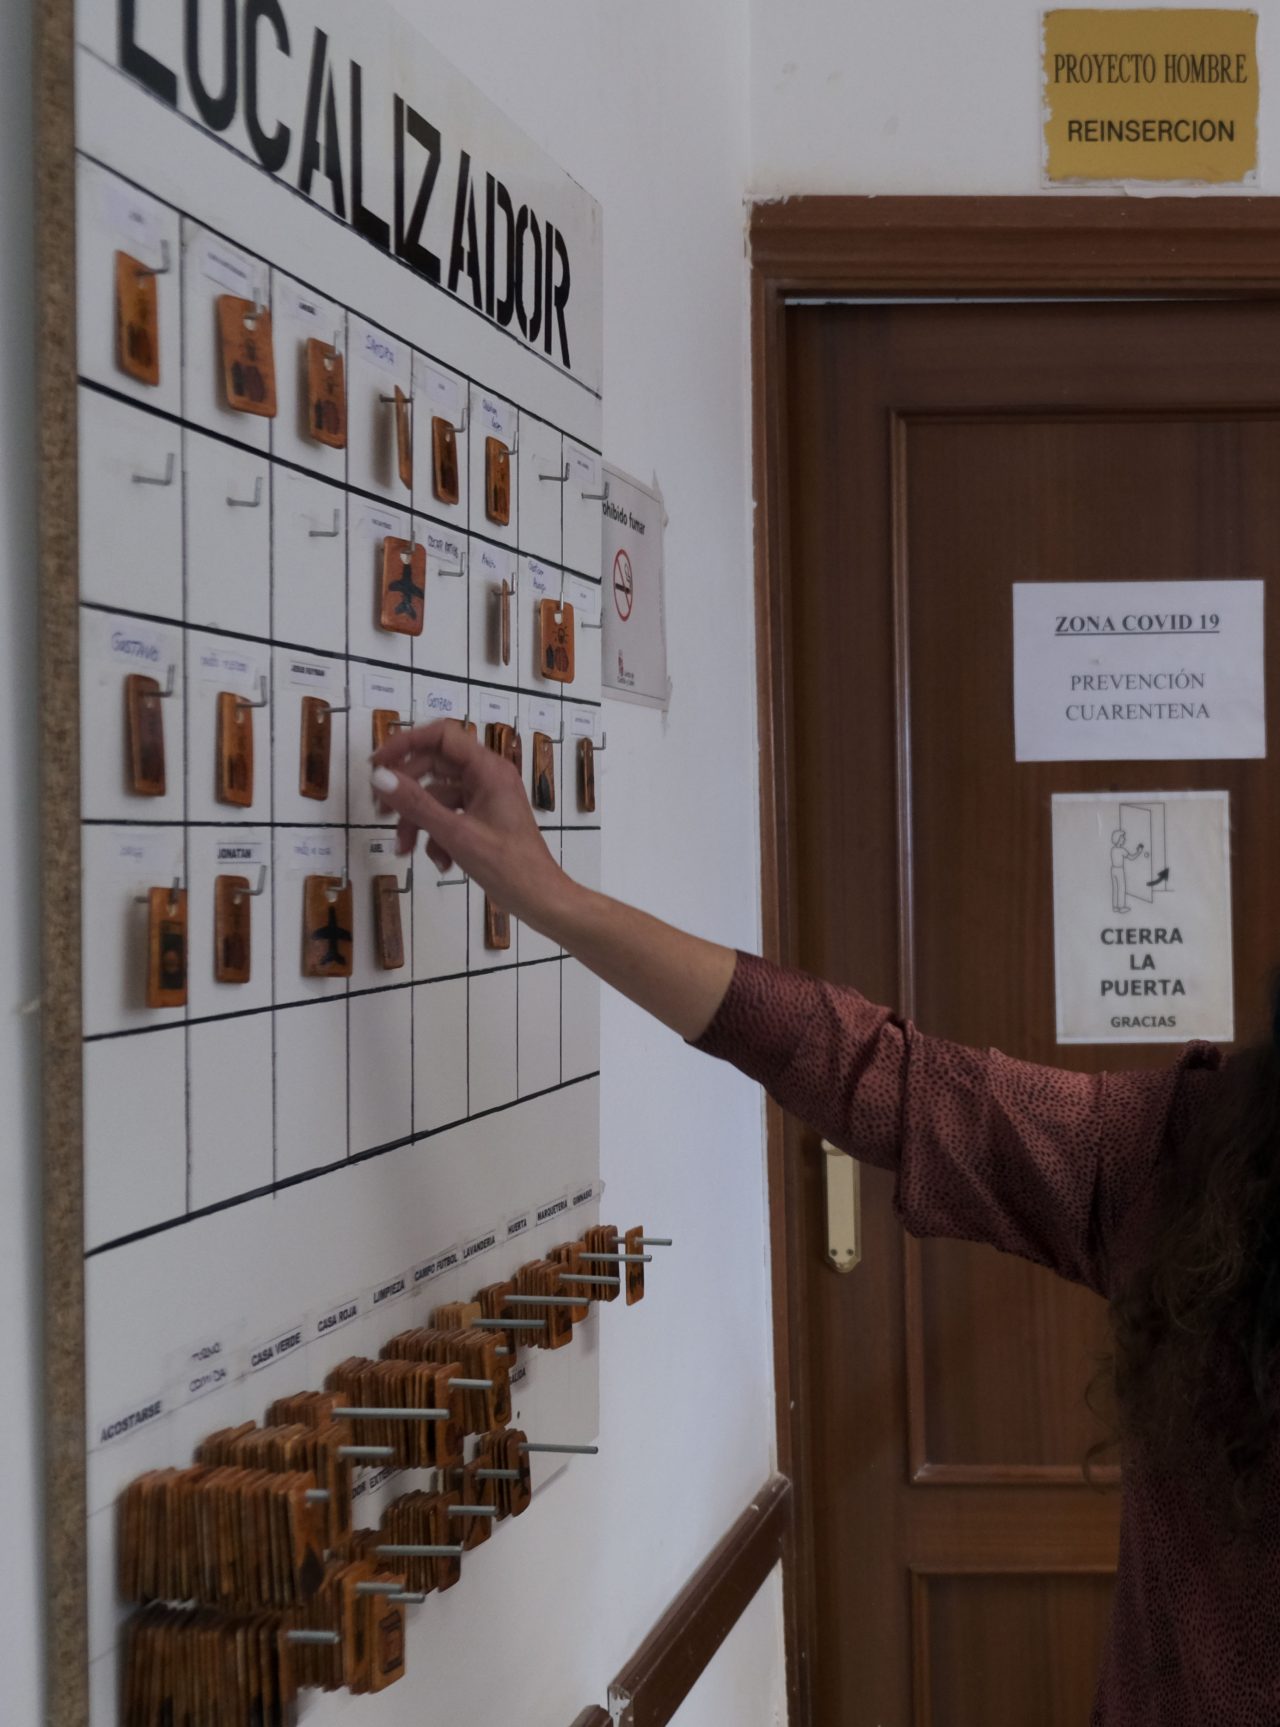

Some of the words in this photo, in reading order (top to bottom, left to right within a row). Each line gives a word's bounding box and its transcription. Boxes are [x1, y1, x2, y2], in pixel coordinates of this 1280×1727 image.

[1053, 53, 1156, 84] PROYECTO
[1163, 53, 1248, 84] HOMBRE
[1067, 119, 1235, 143] REINSERCION
[628, 511, 646, 536] fumar
[1055, 615, 1116, 633] ZONA
[1121, 613, 1193, 632] COVID
[1199, 613, 1220, 631] 19
[1070, 668, 1205, 691] PREVENCIÓN
[1065, 702, 1211, 722] CUARENTENA
[216, 847, 253, 860] JONATAN
[1099, 927, 1184, 945] CIERRA
[1129, 953, 1156, 971] LA
[1100, 979, 1186, 996] PUERTA
[1110, 1015, 1176, 1028] GRACIAS
[537, 1199, 568, 1221] MARQUETERIA
[507, 1217, 527, 1235] HUERTA
[463, 1235, 496, 1260] LAVANDERIA
[414, 1263, 435, 1282] CAMPO
[436, 1253, 458, 1273] FUTBOL
[373, 1279, 405, 1303] LIMPIEZA
[317, 1314, 337, 1332] CASA
[338, 1305, 358, 1324] ROJA
[251, 1349, 274, 1367] CASA
[275, 1331, 302, 1353] VERDE
[510, 1367, 526, 1384] ALIDA
[101, 1400, 163, 1443] ACOSTARSE
